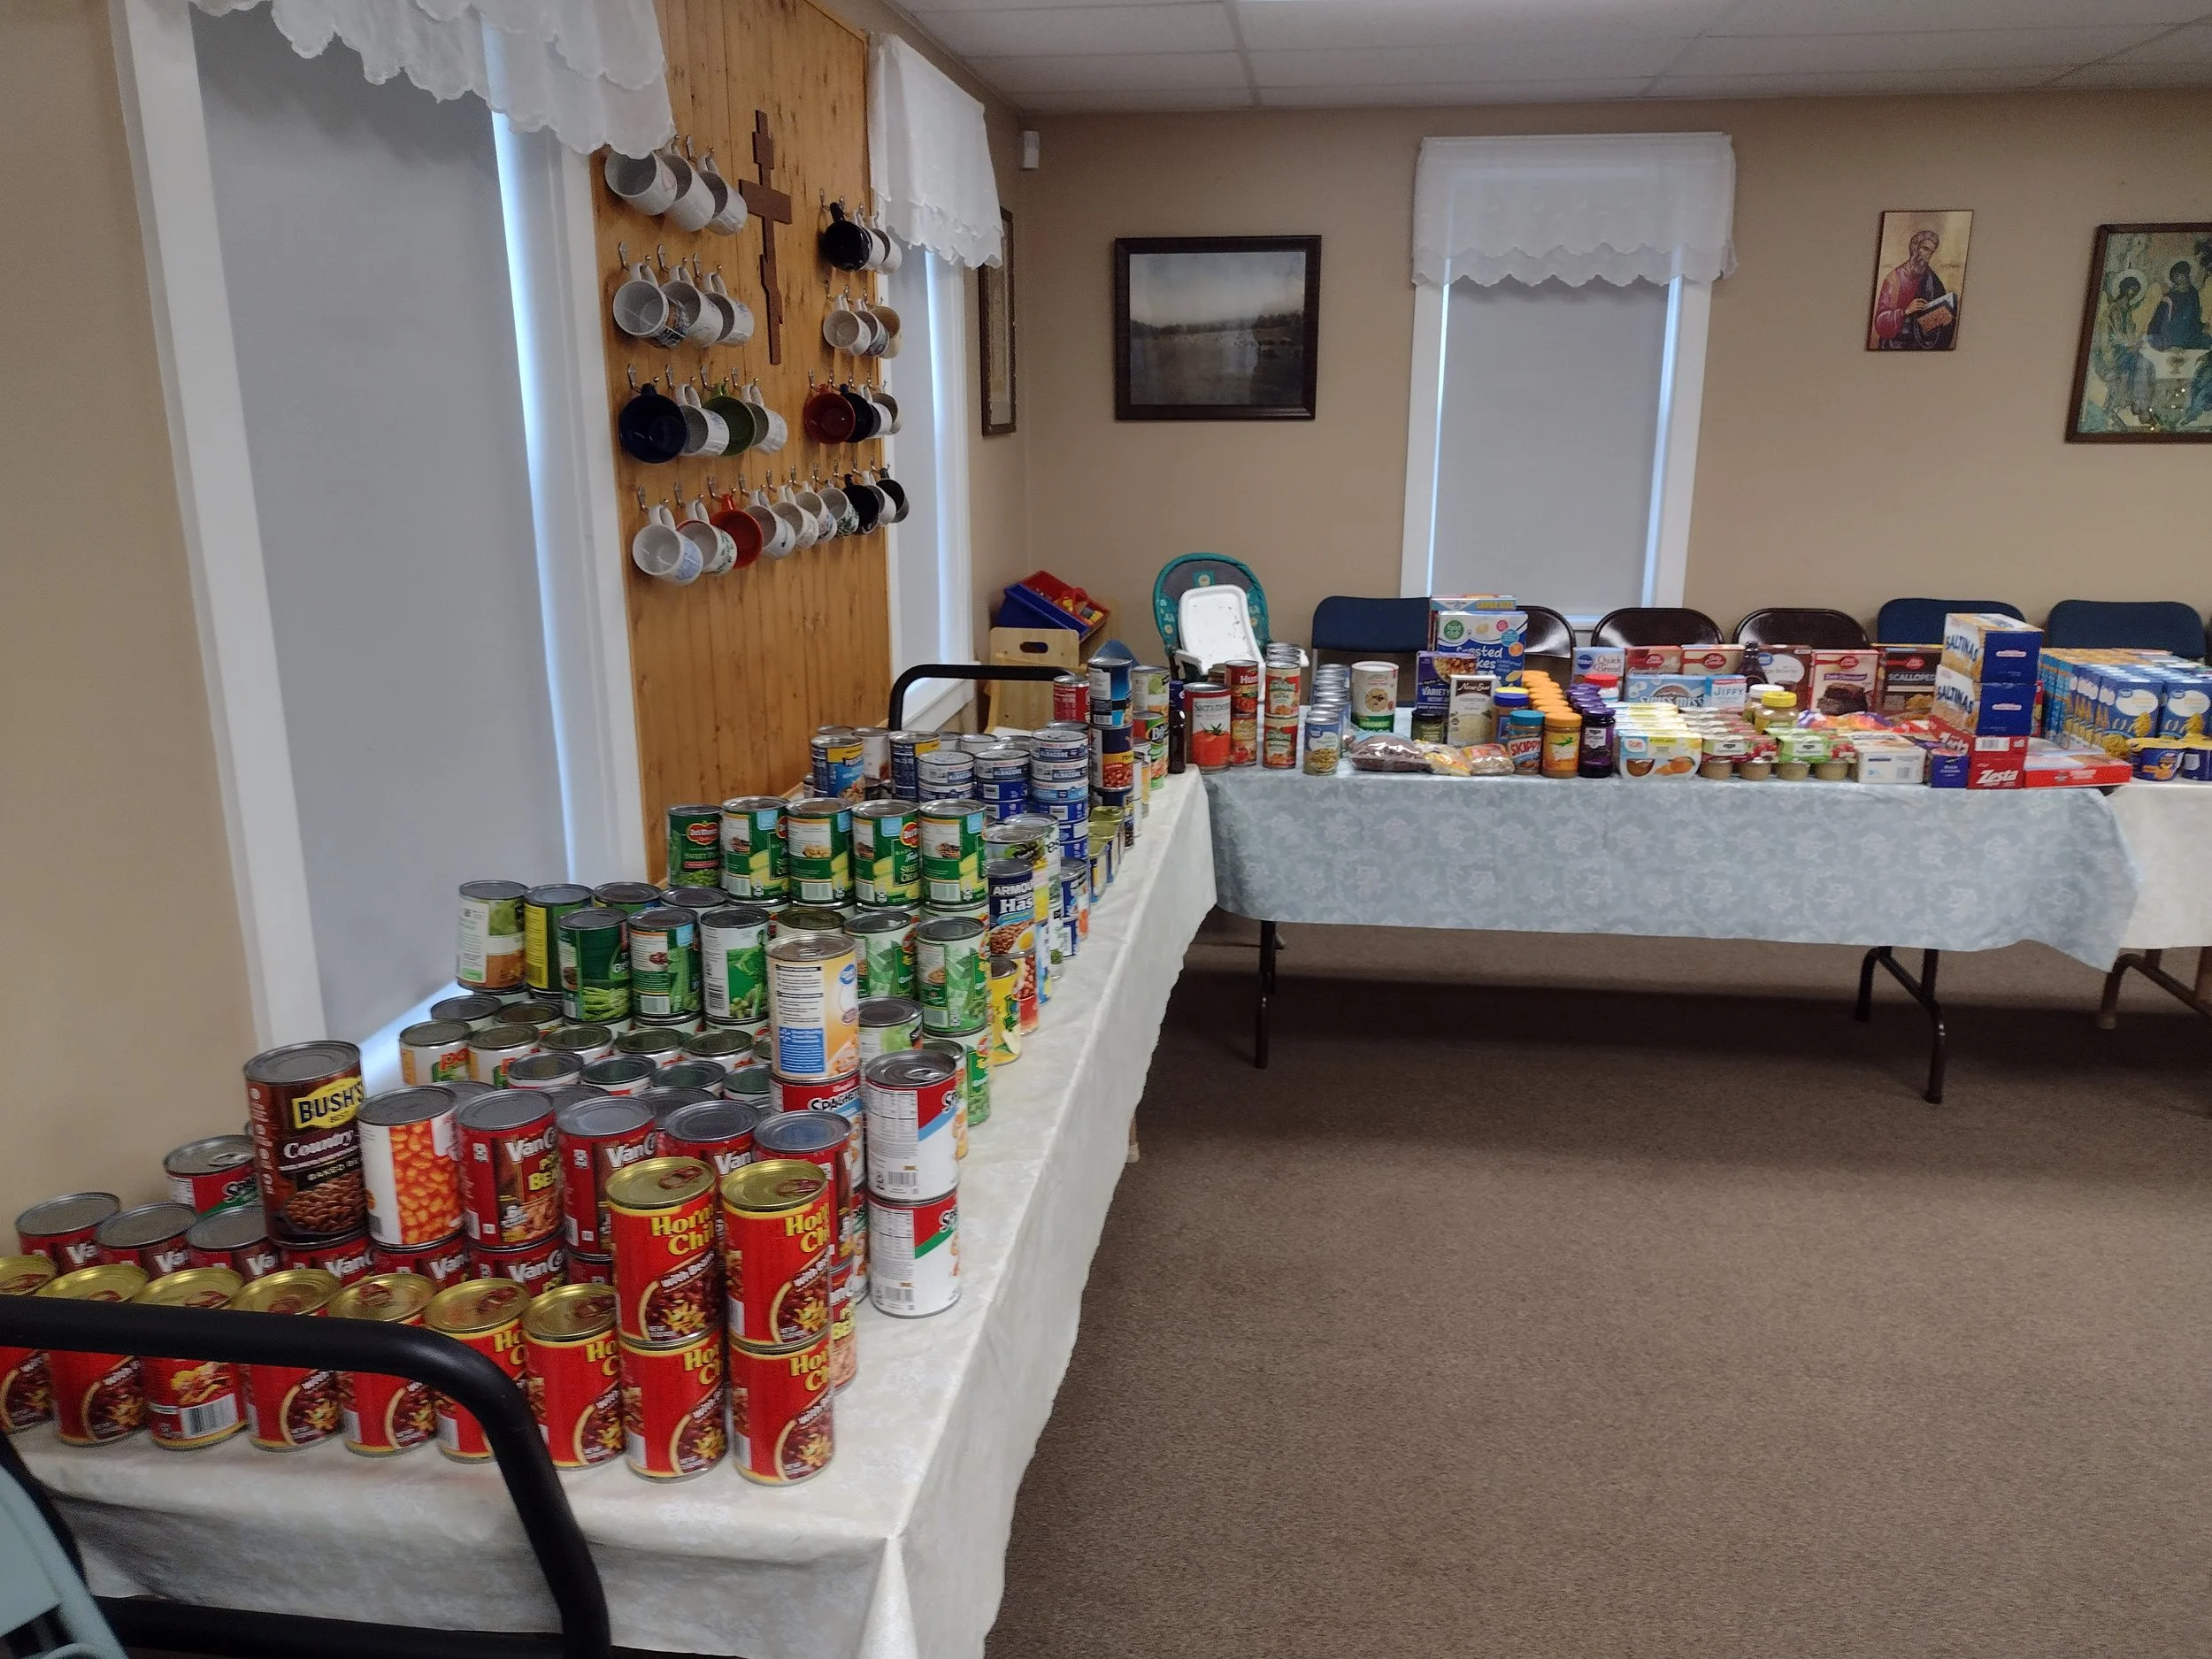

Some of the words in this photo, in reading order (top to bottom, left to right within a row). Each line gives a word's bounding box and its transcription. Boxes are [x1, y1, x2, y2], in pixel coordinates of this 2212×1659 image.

[1598, 655, 1622, 664] Quick
[1946, 635, 1980, 663] SALTINAS
[1937, 686, 1974, 714] SALTINAS
[1977, 770, 2018, 784] Zesta
[999, 897, 1033, 914] Has
[283, 1130, 354, 1159] Country
